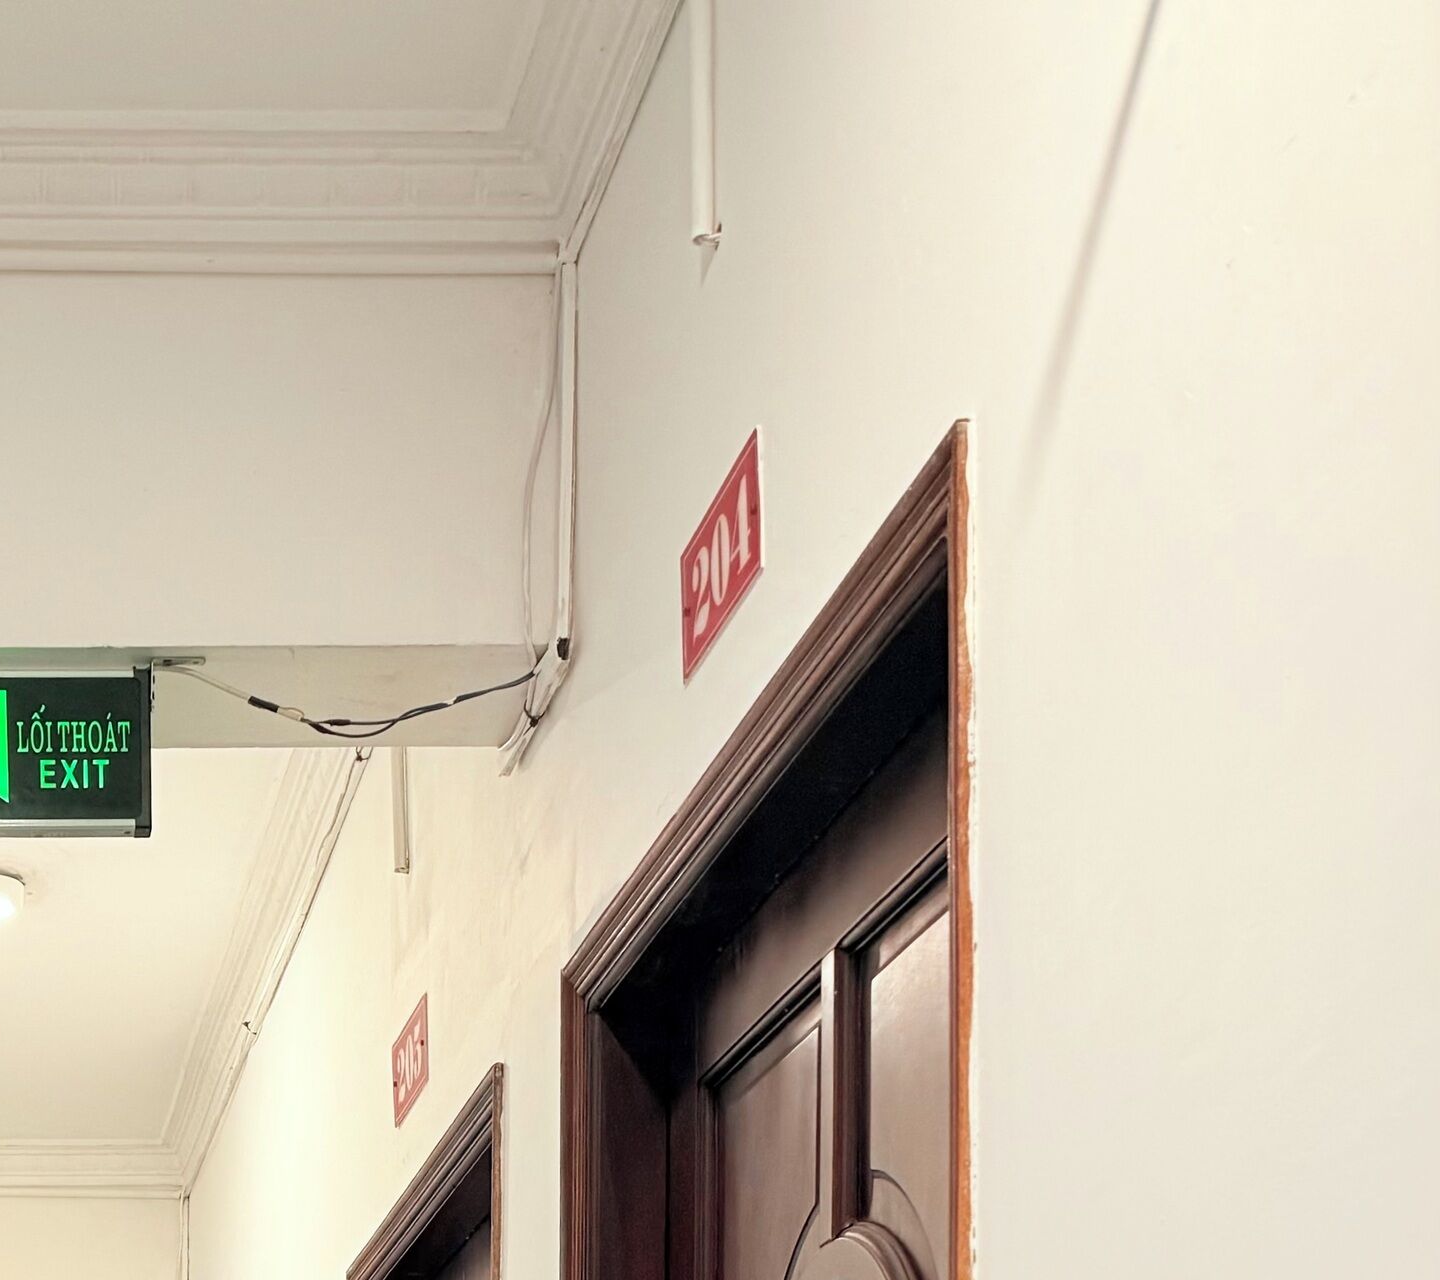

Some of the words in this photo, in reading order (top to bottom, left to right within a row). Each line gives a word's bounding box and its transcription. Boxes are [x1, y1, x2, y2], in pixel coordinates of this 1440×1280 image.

[691, 473, 752, 646] 204
[16, 704, 53, 753] LỐI
[57, 712, 130, 753] THOÁT
[39, 759, 110, 789] EXIT
